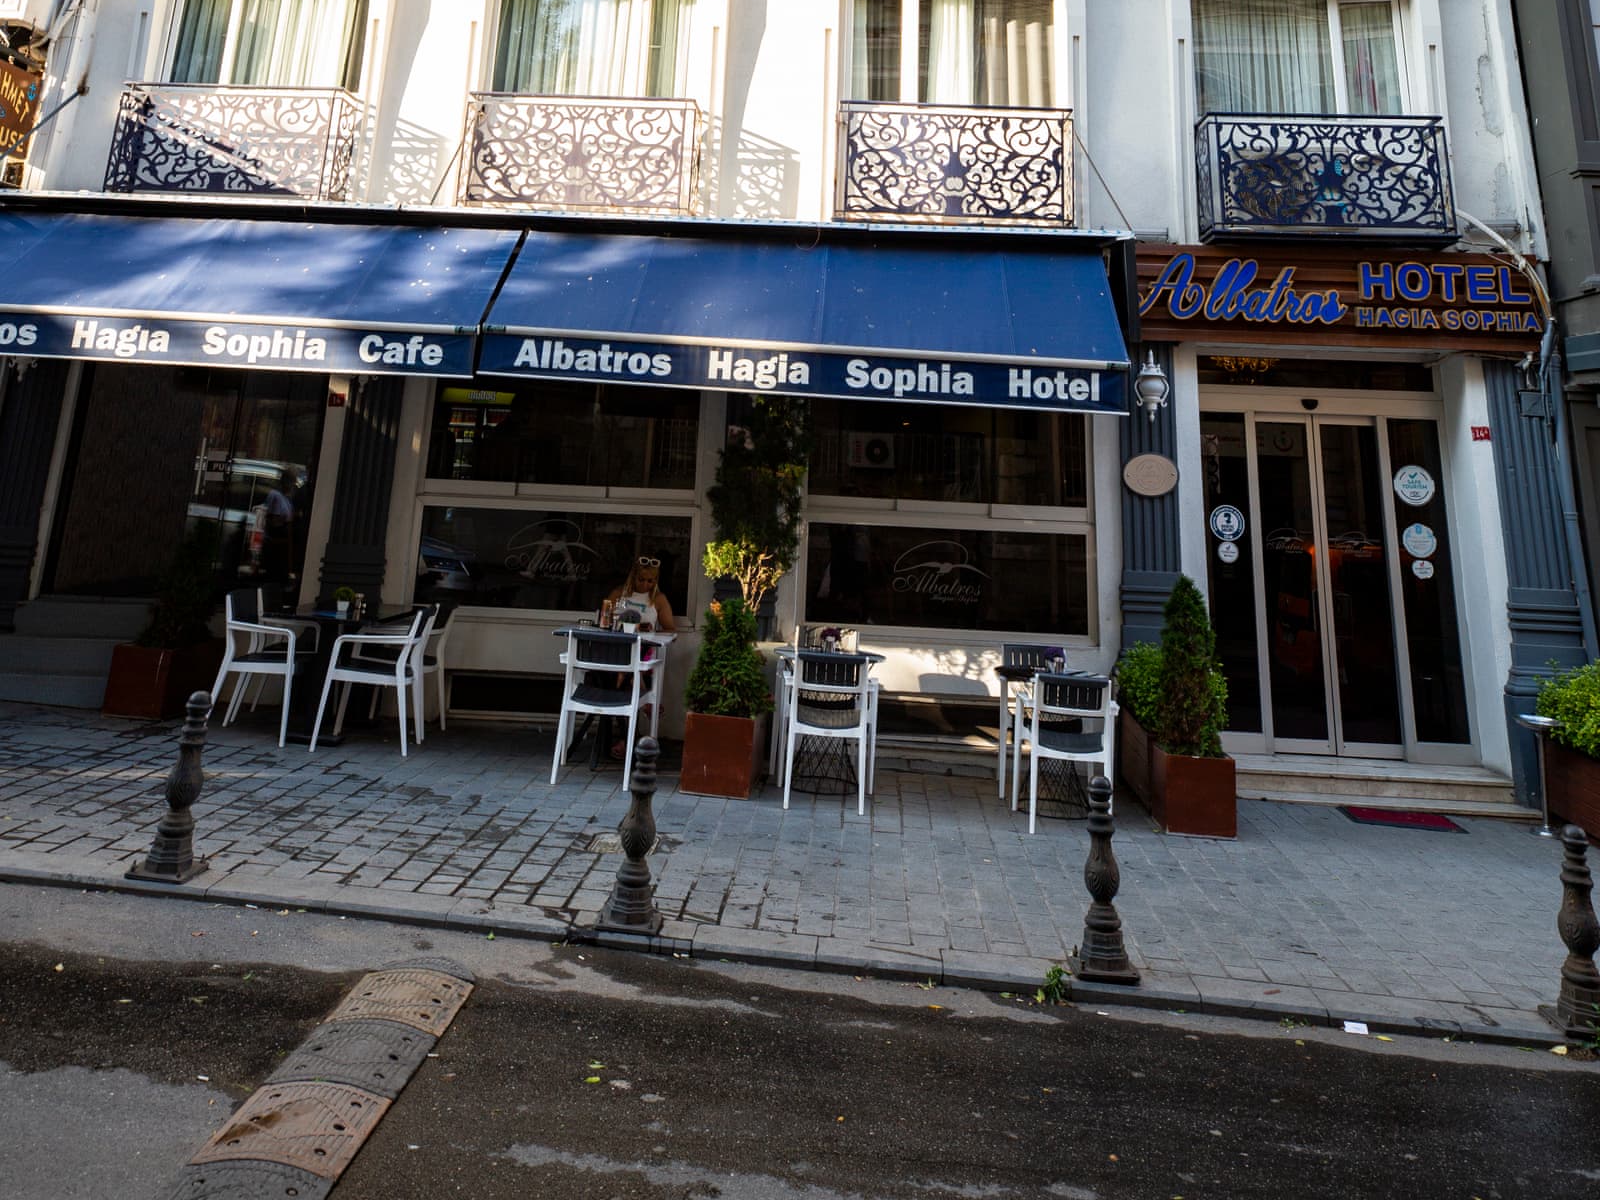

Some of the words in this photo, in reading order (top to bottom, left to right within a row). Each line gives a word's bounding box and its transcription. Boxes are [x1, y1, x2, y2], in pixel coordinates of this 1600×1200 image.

[0, 69, 30, 123] HMET
[1139, 252, 1347, 324] Albatros
[1357, 262, 1532, 303] HOTEL
[1355, 306, 1440, 329] HAGIA
[1442, 309, 1543, 332] SOPHIA
[202, 326, 326, 363] Sophia
[358, 334, 443, 366] Cafe
[513, 338, 672, 377] Albatros
[707, 349, 810, 390] Hagia
[845, 358, 974, 397] Sophia
[1008, 368, 1100, 402] Hotel
[892, 569, 981, 595] Albatros
